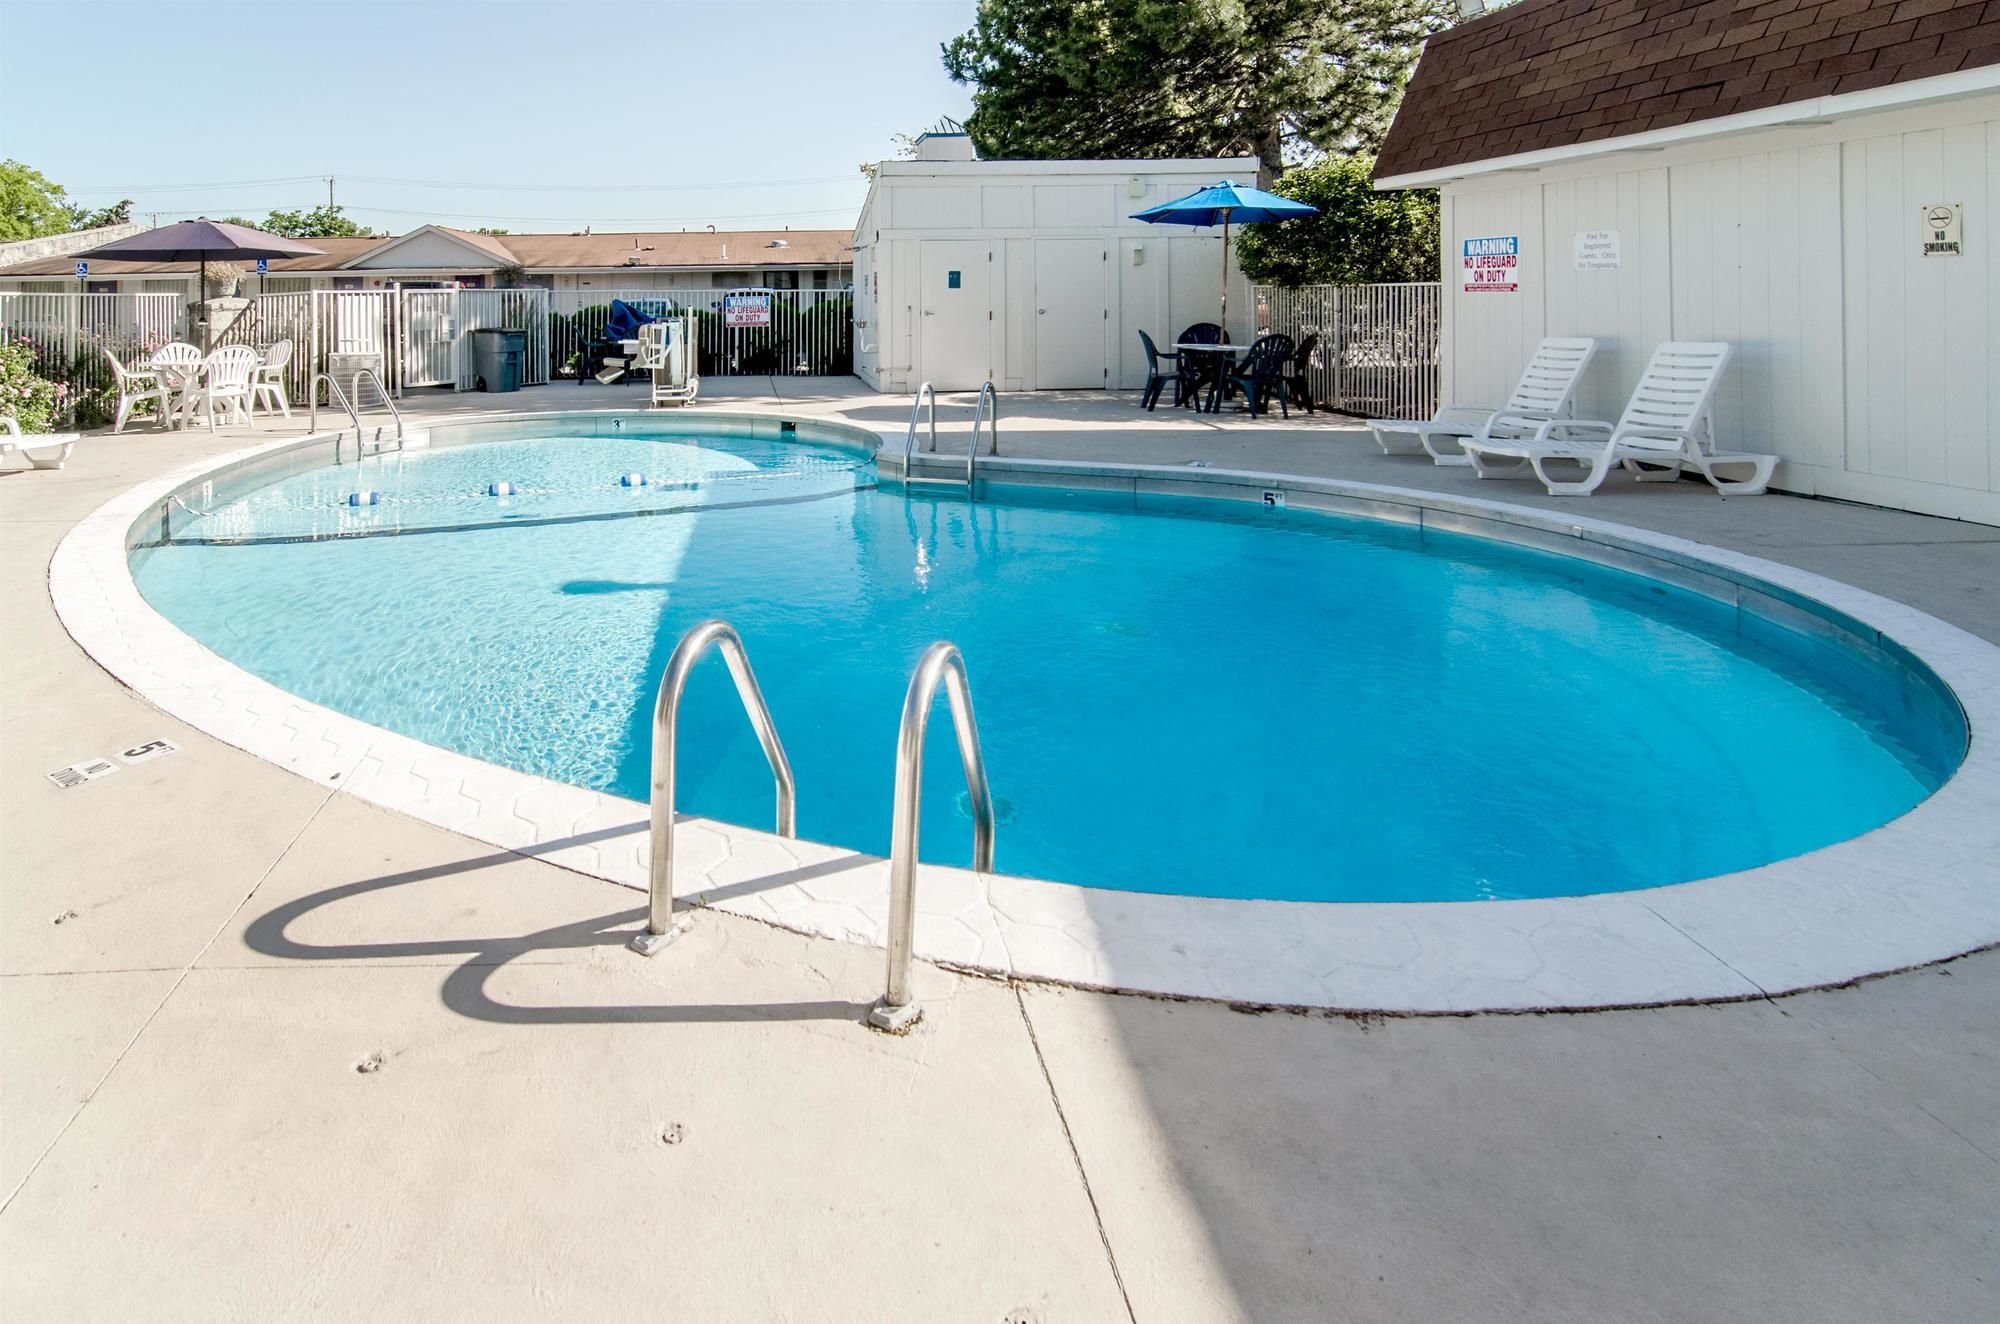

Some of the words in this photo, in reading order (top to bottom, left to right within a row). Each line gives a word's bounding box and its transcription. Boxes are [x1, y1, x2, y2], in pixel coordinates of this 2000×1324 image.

[1935, 231, 1945, 241] NO
[1467, 239, 1514, 255] WARNING
[1924, 242, 1959, 253] SMOKING
[1464, 257, 1474, 269] NO
[1476, 256, 1517, 269] LIFEGUARD
[1474, 270, 1484, 282] ON
[1487, 270, 1506, 282] DUTY
[729, 297, 766, 306] WARNING
[1264, 492, 1275, 505] 5
[124, 740, 167, 757] 5
